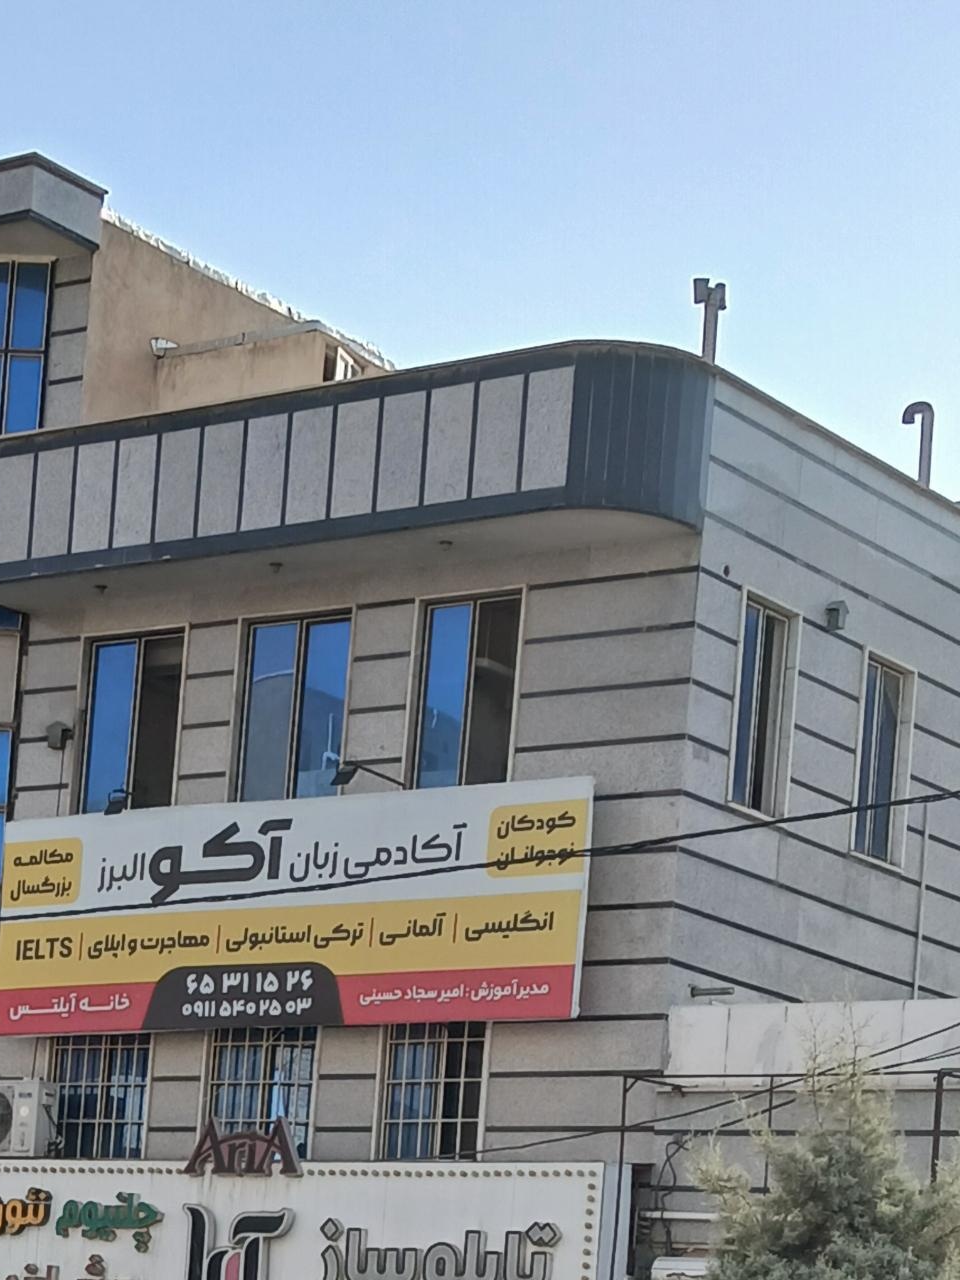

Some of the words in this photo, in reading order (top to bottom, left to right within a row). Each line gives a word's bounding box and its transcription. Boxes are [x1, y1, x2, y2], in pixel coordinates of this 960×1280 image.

[496, 811, 576, 839] کودکان
[13, 849, 74, 867] مکالمه
[148, 818, 293, 905] آکو
[289, 842, 340, 884] زبان
[344, 822, 468, 880] آکادمی
[97, 849, 146, 893] البرز
[10, 875, 72, 901] بزرگسال
[226, 925, 311, 952] استانبولی
[313, 921, 364, 949] ترکی
[379, 912, 444, 945] آلمانی
[464, 911, 554, 941] انگلیسی
[16, 937, 73, 961] IELTS
[128, 938, 139, 956] و
[140, 931, 210, 954] مهاجرت
[186, 973, 215, 994] ۶۵
[222, 972, 249, 993] ۳۱
[256, 971, 279, 993] ۱۵
[286, 969, 314, 992] ۲۶
[405, 985, 438, 1003] سجاد
[437, 983, 464, 1002] امیر
[516, 981, 549, 1000] مدیر
[9, 993, 77, 1020] آیلتس
[79, 992, 130, 1012] خانه
[182, 1001, 216, 1018] ۰۹۱۱
[259, 999, 282, 1016] ۲۵
[285, 997, 313, 1015] ۰۳
[359, 988, 402, 1005] حسینی
